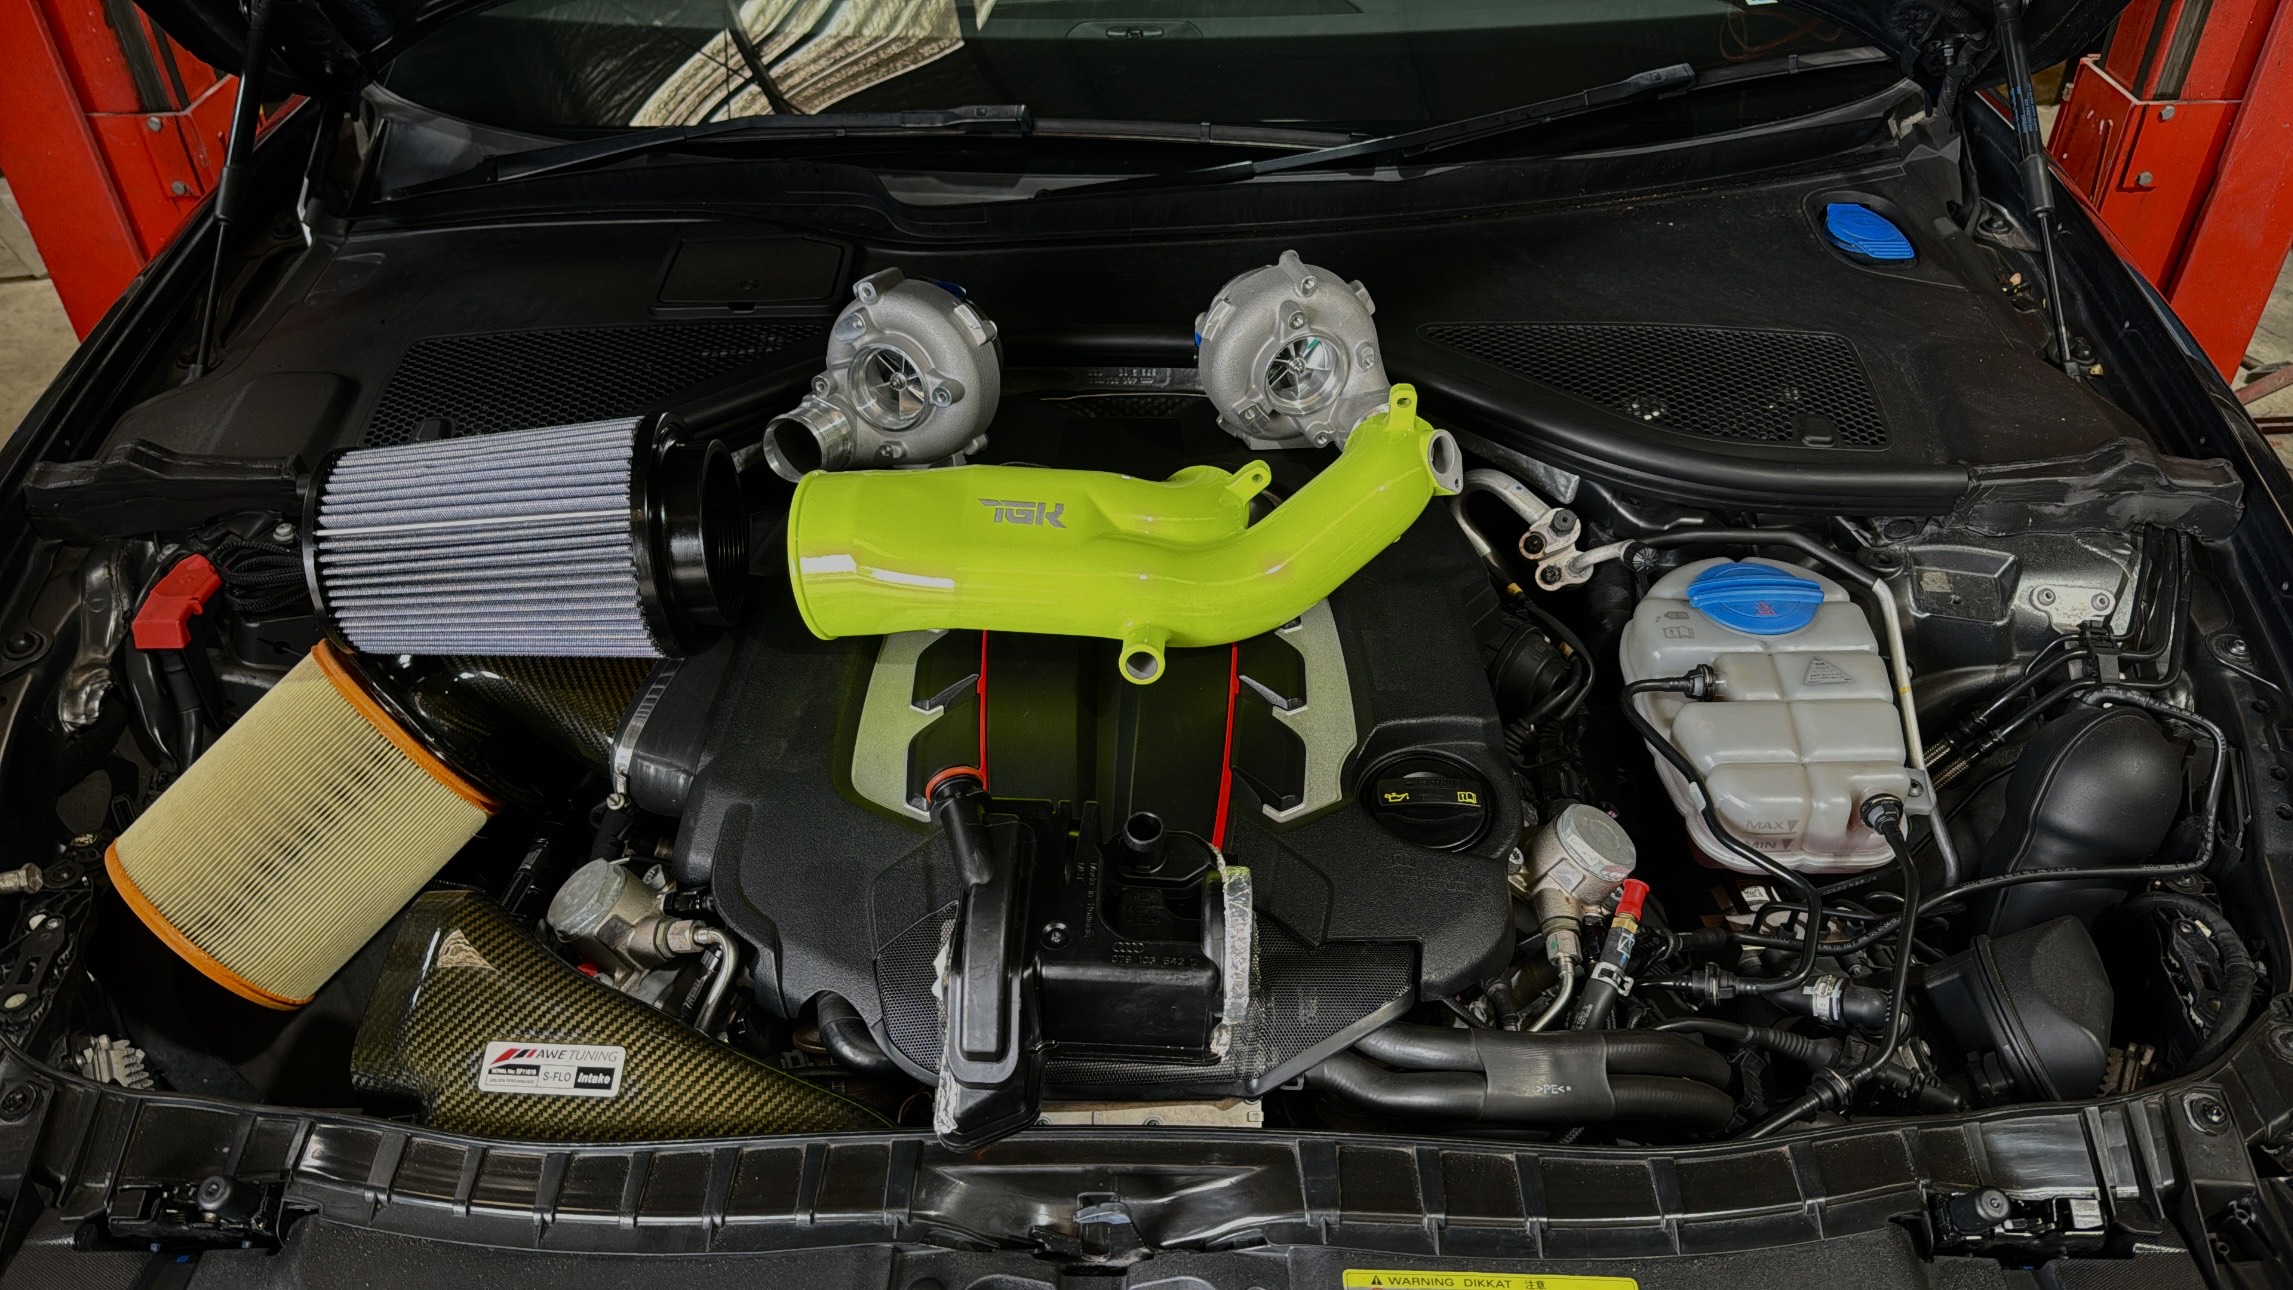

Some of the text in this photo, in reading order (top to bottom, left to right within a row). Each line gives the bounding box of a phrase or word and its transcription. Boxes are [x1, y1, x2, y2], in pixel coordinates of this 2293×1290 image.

[977, 498, 1066, 528] TGK
[1746, 819, 1784, 830] MAX
[1138, 956, 1156, 965] 103
[536, 1049, 618, 1062] AWE TUNING
[543, 1071, 571, 1082] S-FLO
[577, 1072, 612, 1084] Intake
[1388, 1276, 1512, 1290] WARNING DIKKAT
